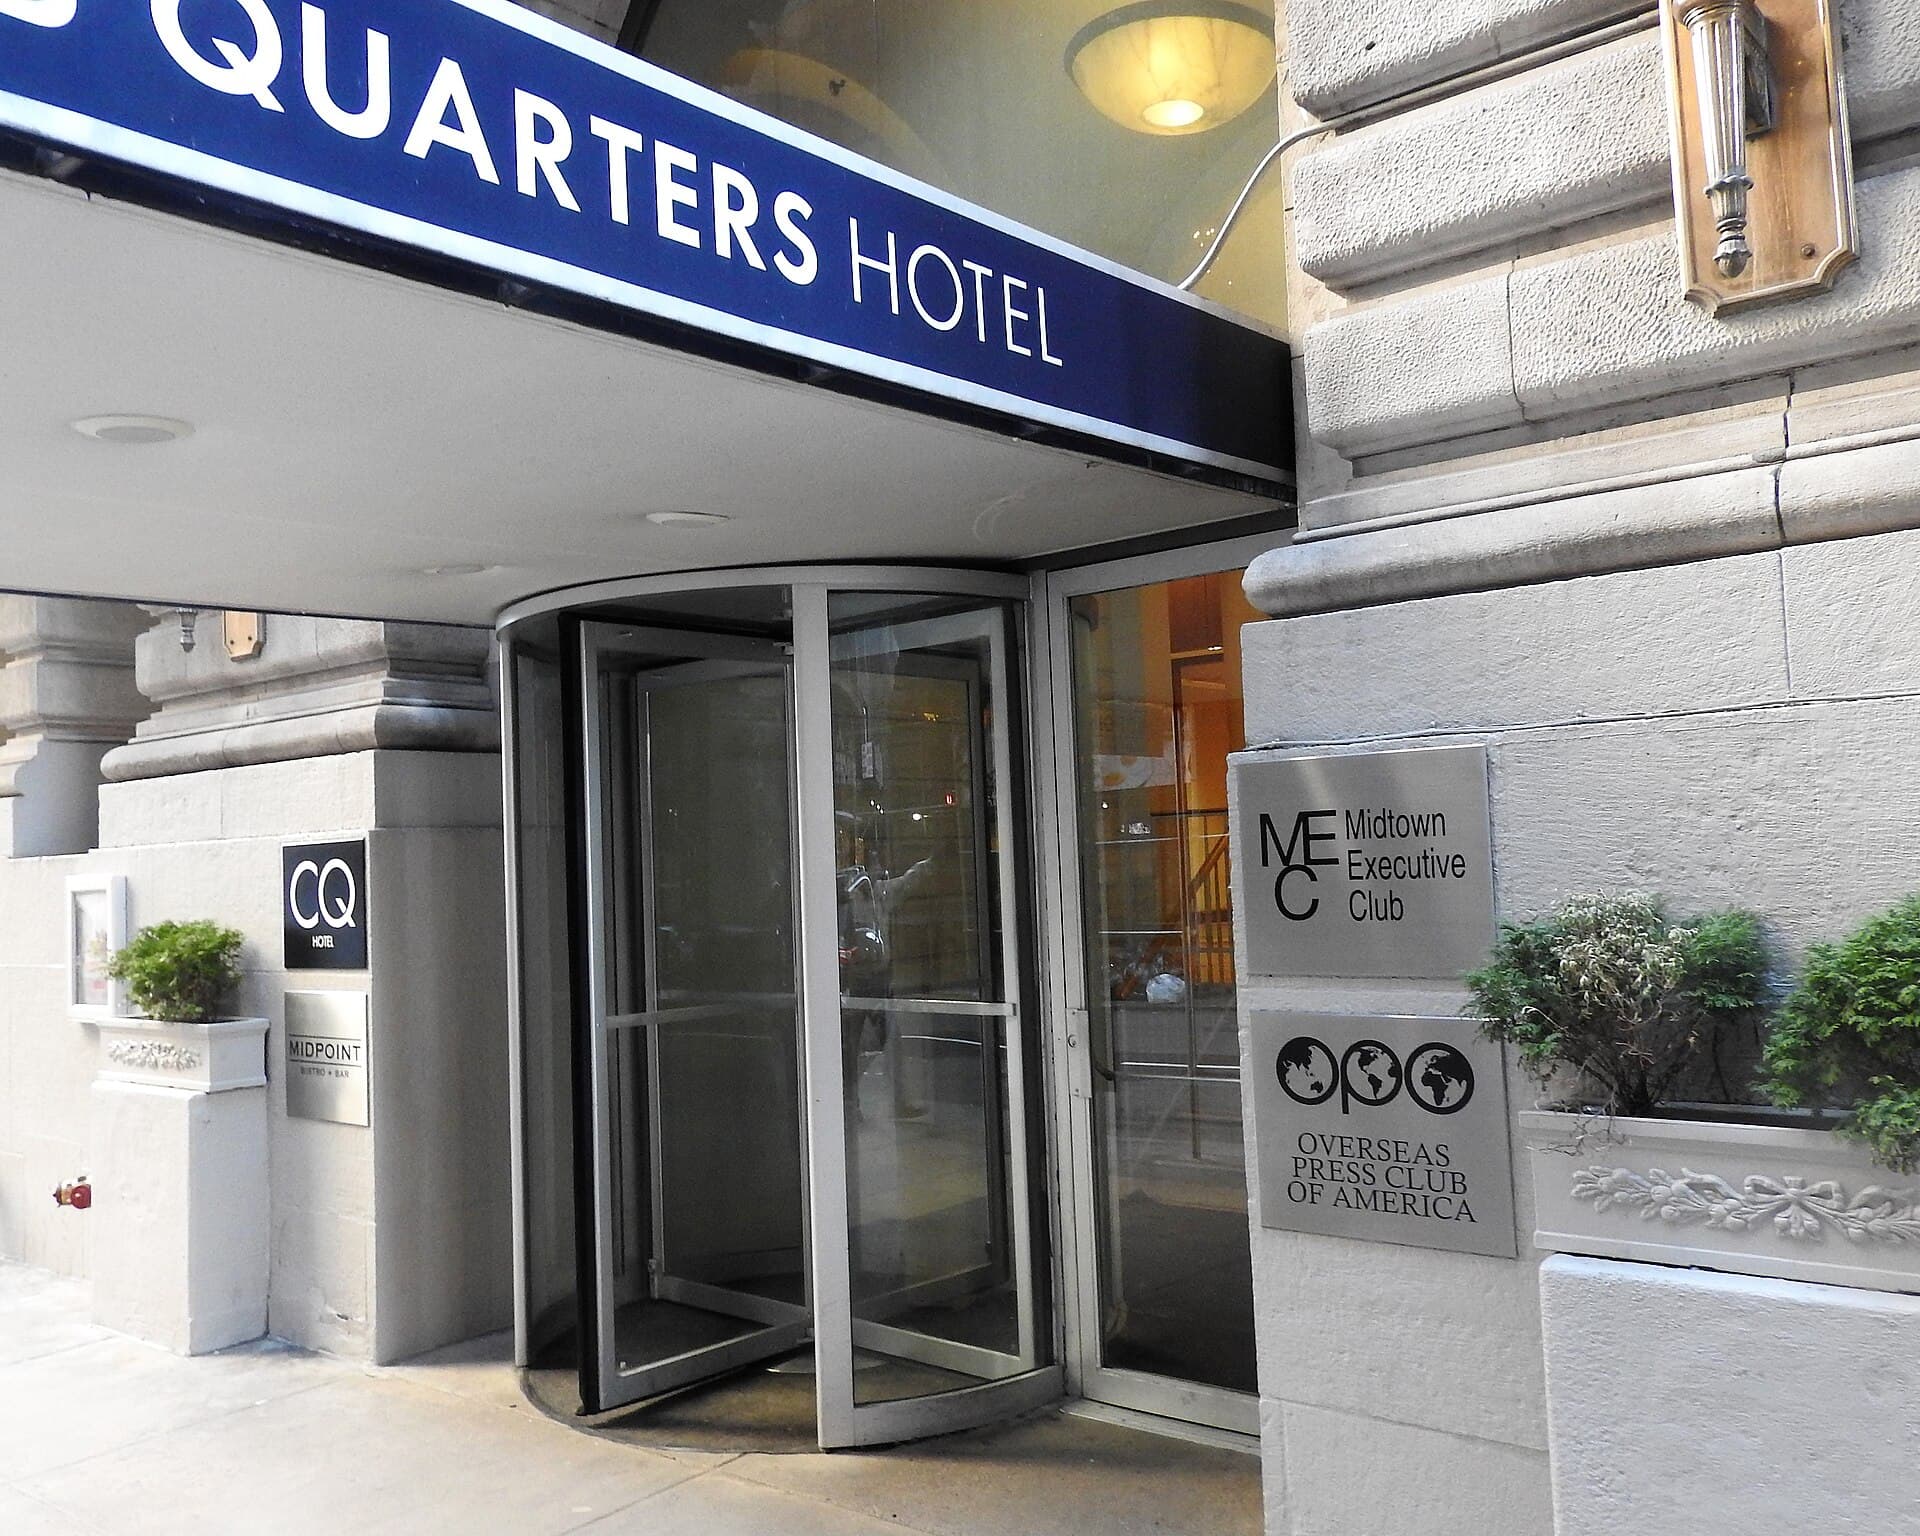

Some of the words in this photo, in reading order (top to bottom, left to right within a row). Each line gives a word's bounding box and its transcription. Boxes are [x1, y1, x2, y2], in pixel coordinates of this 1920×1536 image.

[150, 0, 818, 285] QUARTERS
[849, 216, 1063, 367] HOTEL
[1345, 808, 1446, 840] Midtown
[1347, 848, 1466, 881] Executive
[289, 858, 356, 929] CQ
[1349, 889, 1404, 922] Club
[311, 935, 335, 948] HOTEL
[289, 1040, 361, 1061] MIDPOINT
[1297, 1132, 1450, 1168] OVERSEAS
[1291, 1156, 1376, 1186] PRESS
[1384, 1165, 1468, 1195] CLUB
[1287, 1180, 1325, 1205] OF
[1332, 1186, 1478, 1224] AMERICA
